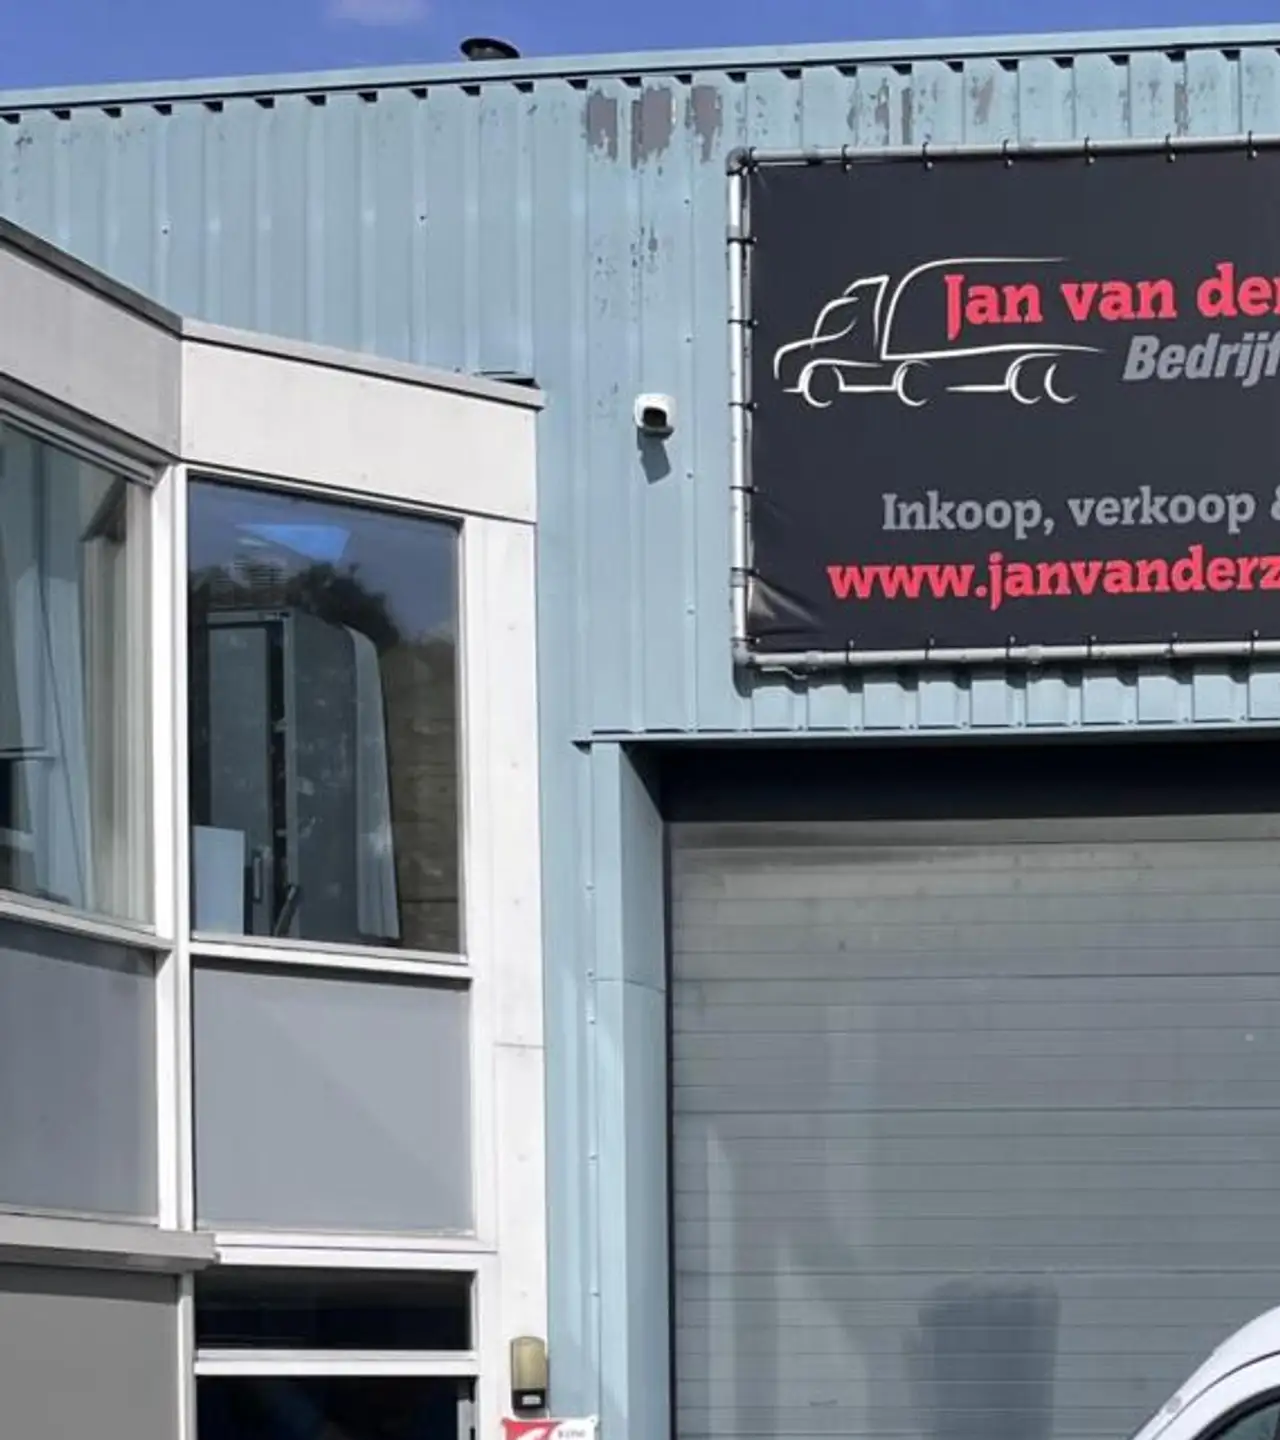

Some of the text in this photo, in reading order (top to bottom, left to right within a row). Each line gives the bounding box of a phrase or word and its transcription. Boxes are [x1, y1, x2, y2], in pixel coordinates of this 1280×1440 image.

[944, 272, 1043, 342] Jan
[1061, 277, 1177, 323] van
[880, 490, 1055, 541] Inkoop,
[1067, 484, 1251, 534] verkoop
